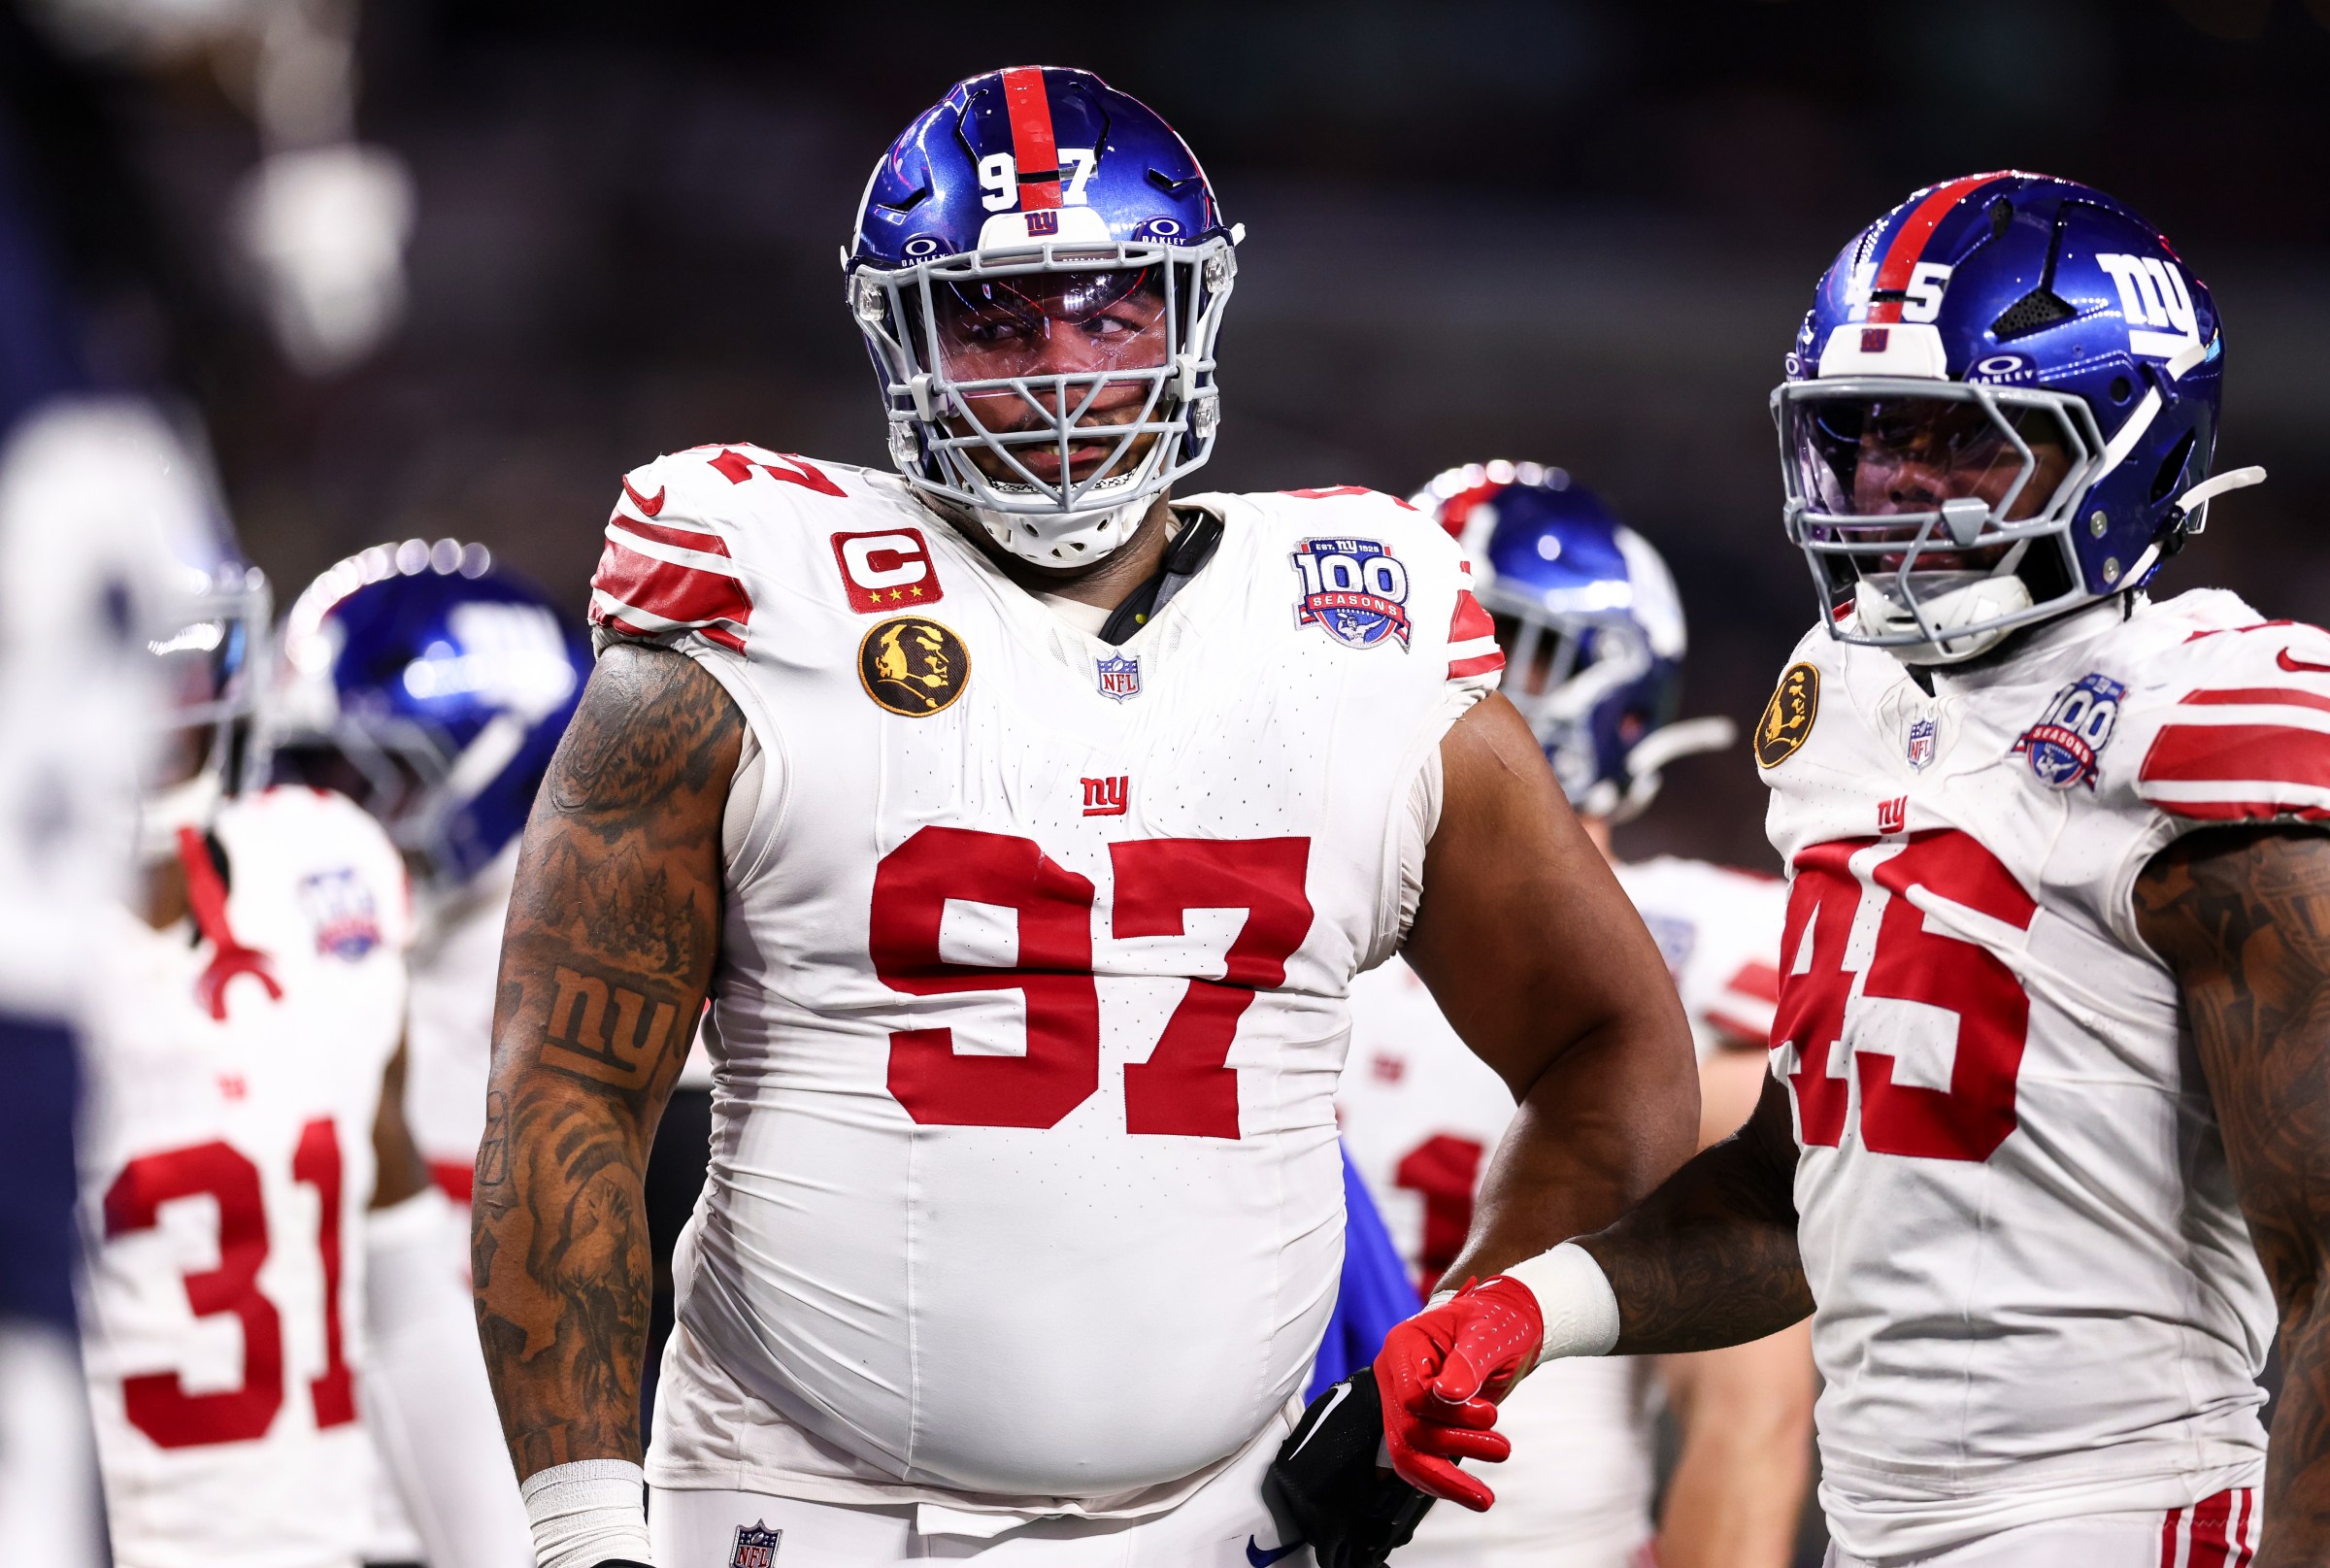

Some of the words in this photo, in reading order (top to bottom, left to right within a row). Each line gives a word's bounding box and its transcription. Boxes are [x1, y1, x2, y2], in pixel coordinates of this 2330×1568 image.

[1142, 235, 1185, 246] OAKLEY
[842, 534, 927, 589] C
[1315, 543, 1336, 551] EST.
[1296, 553, 1407, 603] 100
[1313, 595, 1397, 617] SEASONS
[1103, 674, 1137, 693] NFL
[2038, 683, 2117, 751] 100
[1910, 739, 1931, 762] NFL
[2032, 726, 2090, 764] SEASONS
[869, 824, 1315, 1141] 97
[1769, 825, 2041, 1164] 45
[102, 1117, 359, 1450] 31
[736, 1546, 770, 1568] NFL
